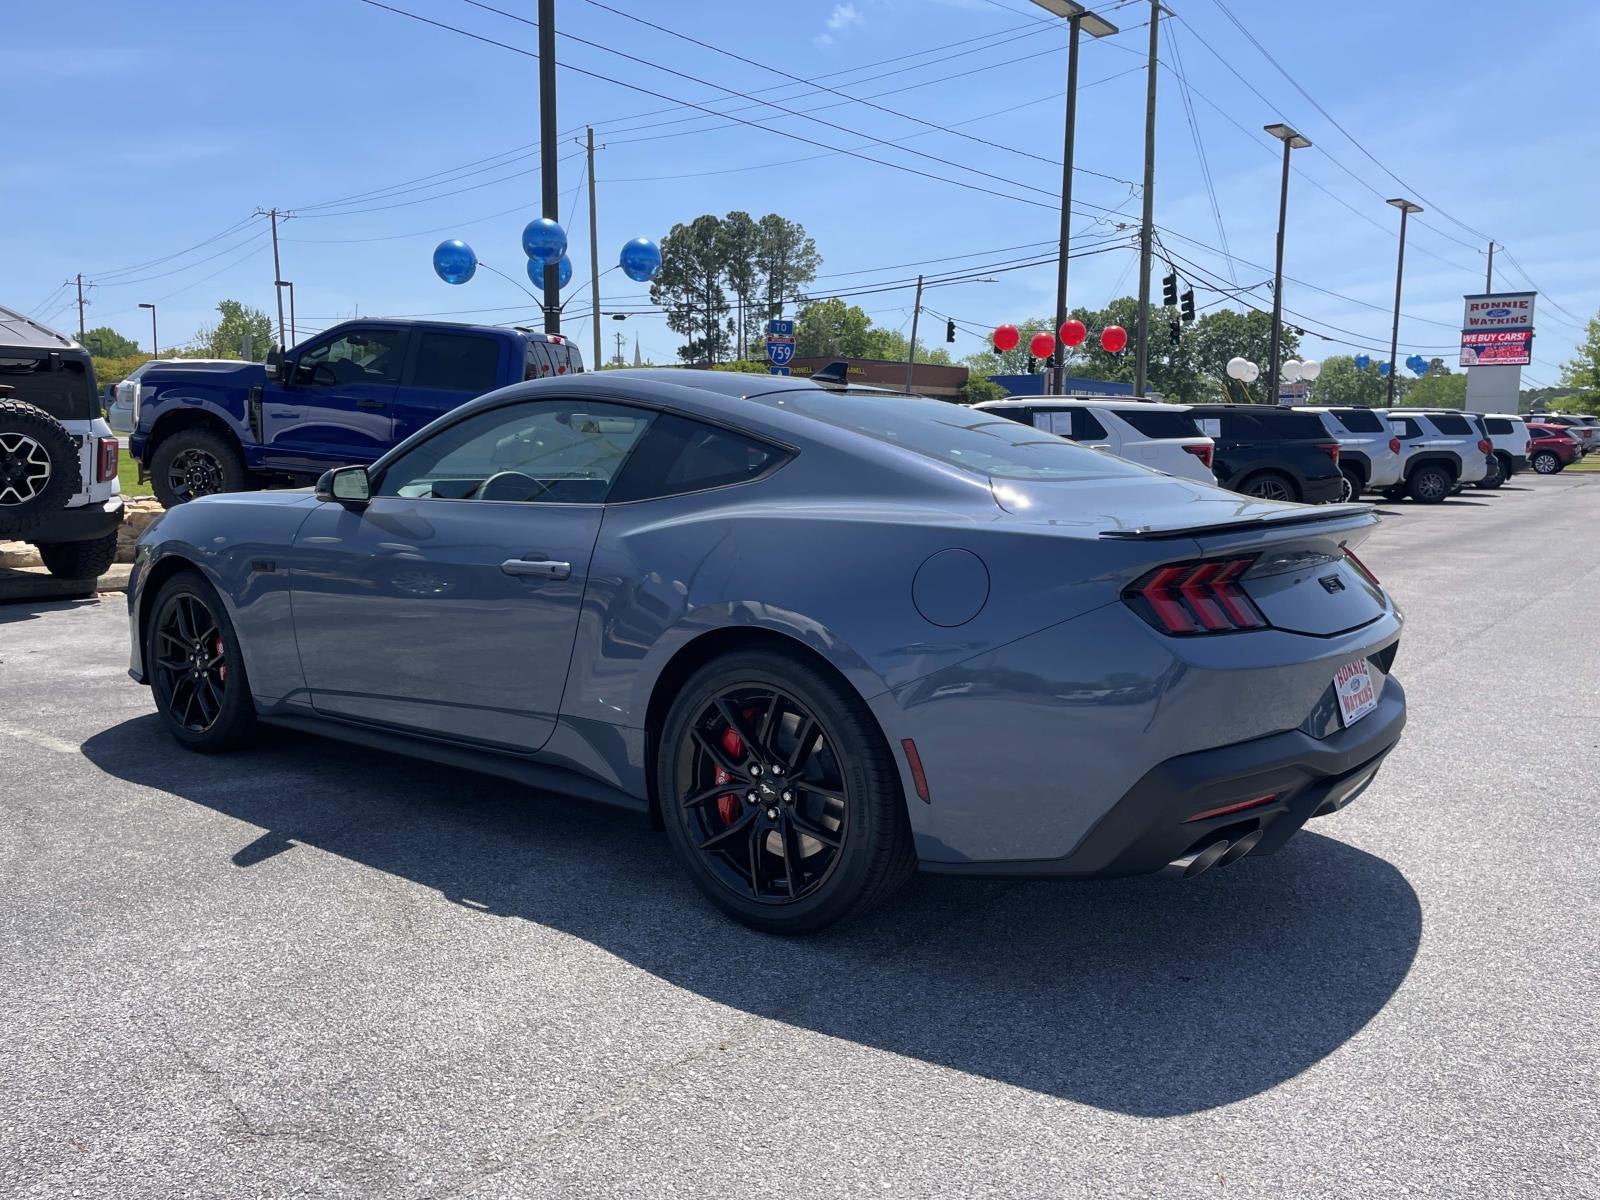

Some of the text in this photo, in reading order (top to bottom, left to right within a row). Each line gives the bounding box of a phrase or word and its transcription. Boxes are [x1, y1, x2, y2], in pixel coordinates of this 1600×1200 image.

[1470, 301, 1528, 311] RONNIE
[1469, 315, 1527, 326] WATKINS
[776, 323, 787, 332] TO
[1463, 332, 1525, 342] WE BUY CARS!
[771, 346, 791, 359] 759
[1342, 680, 1374, 714] WATKINS
